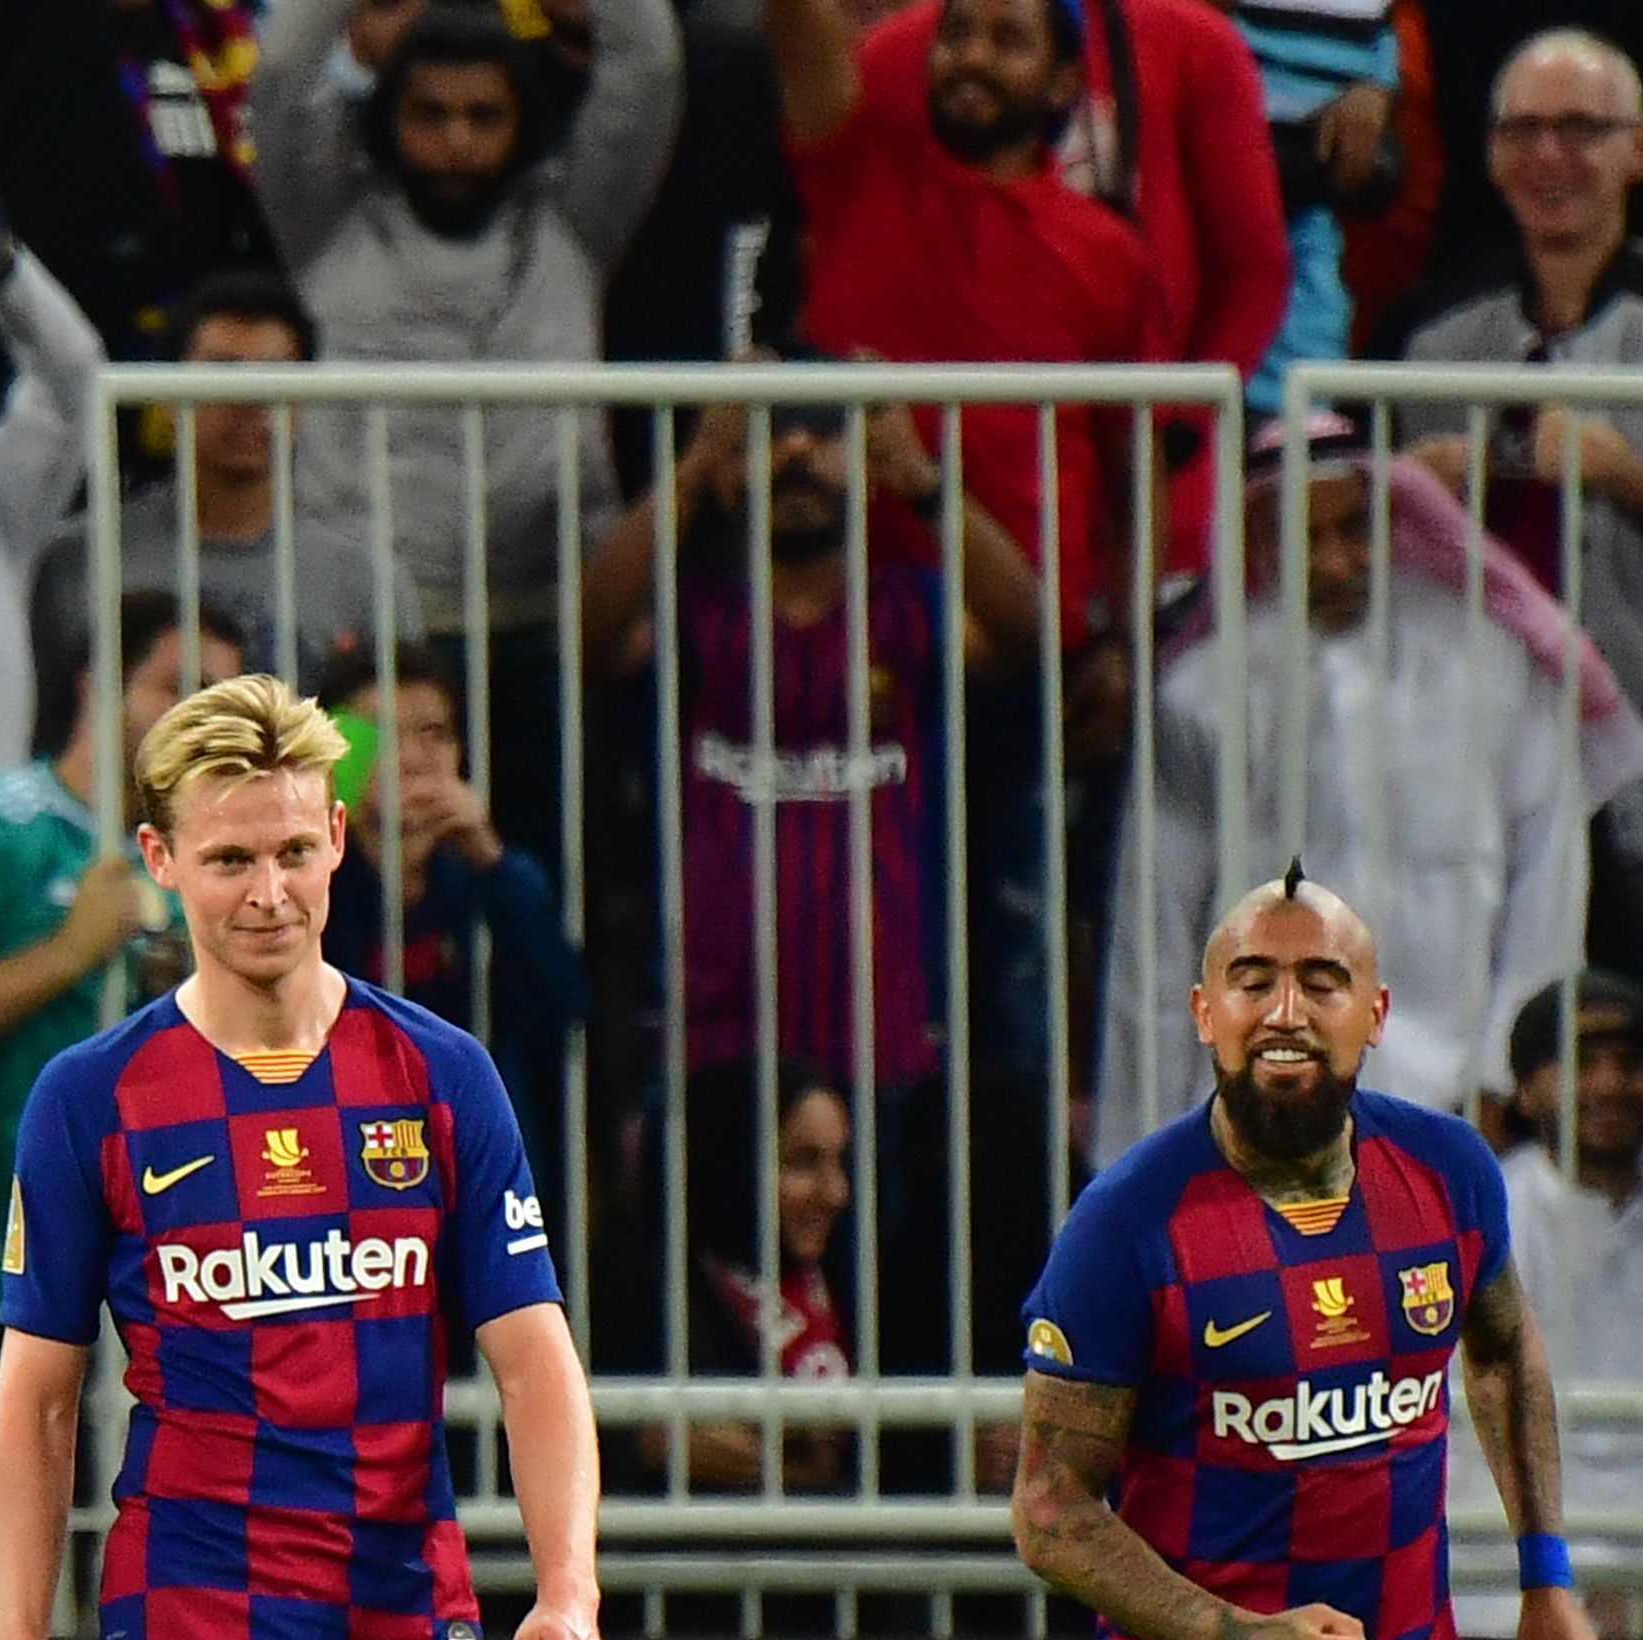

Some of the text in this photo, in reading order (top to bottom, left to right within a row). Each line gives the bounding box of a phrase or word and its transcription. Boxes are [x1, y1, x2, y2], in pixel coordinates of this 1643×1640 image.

[504, 1190, 544, 1230] be
[157, 1229, 429, 1302] Rakuten
[1212, 1371, 1443, 1443] Rakuten
